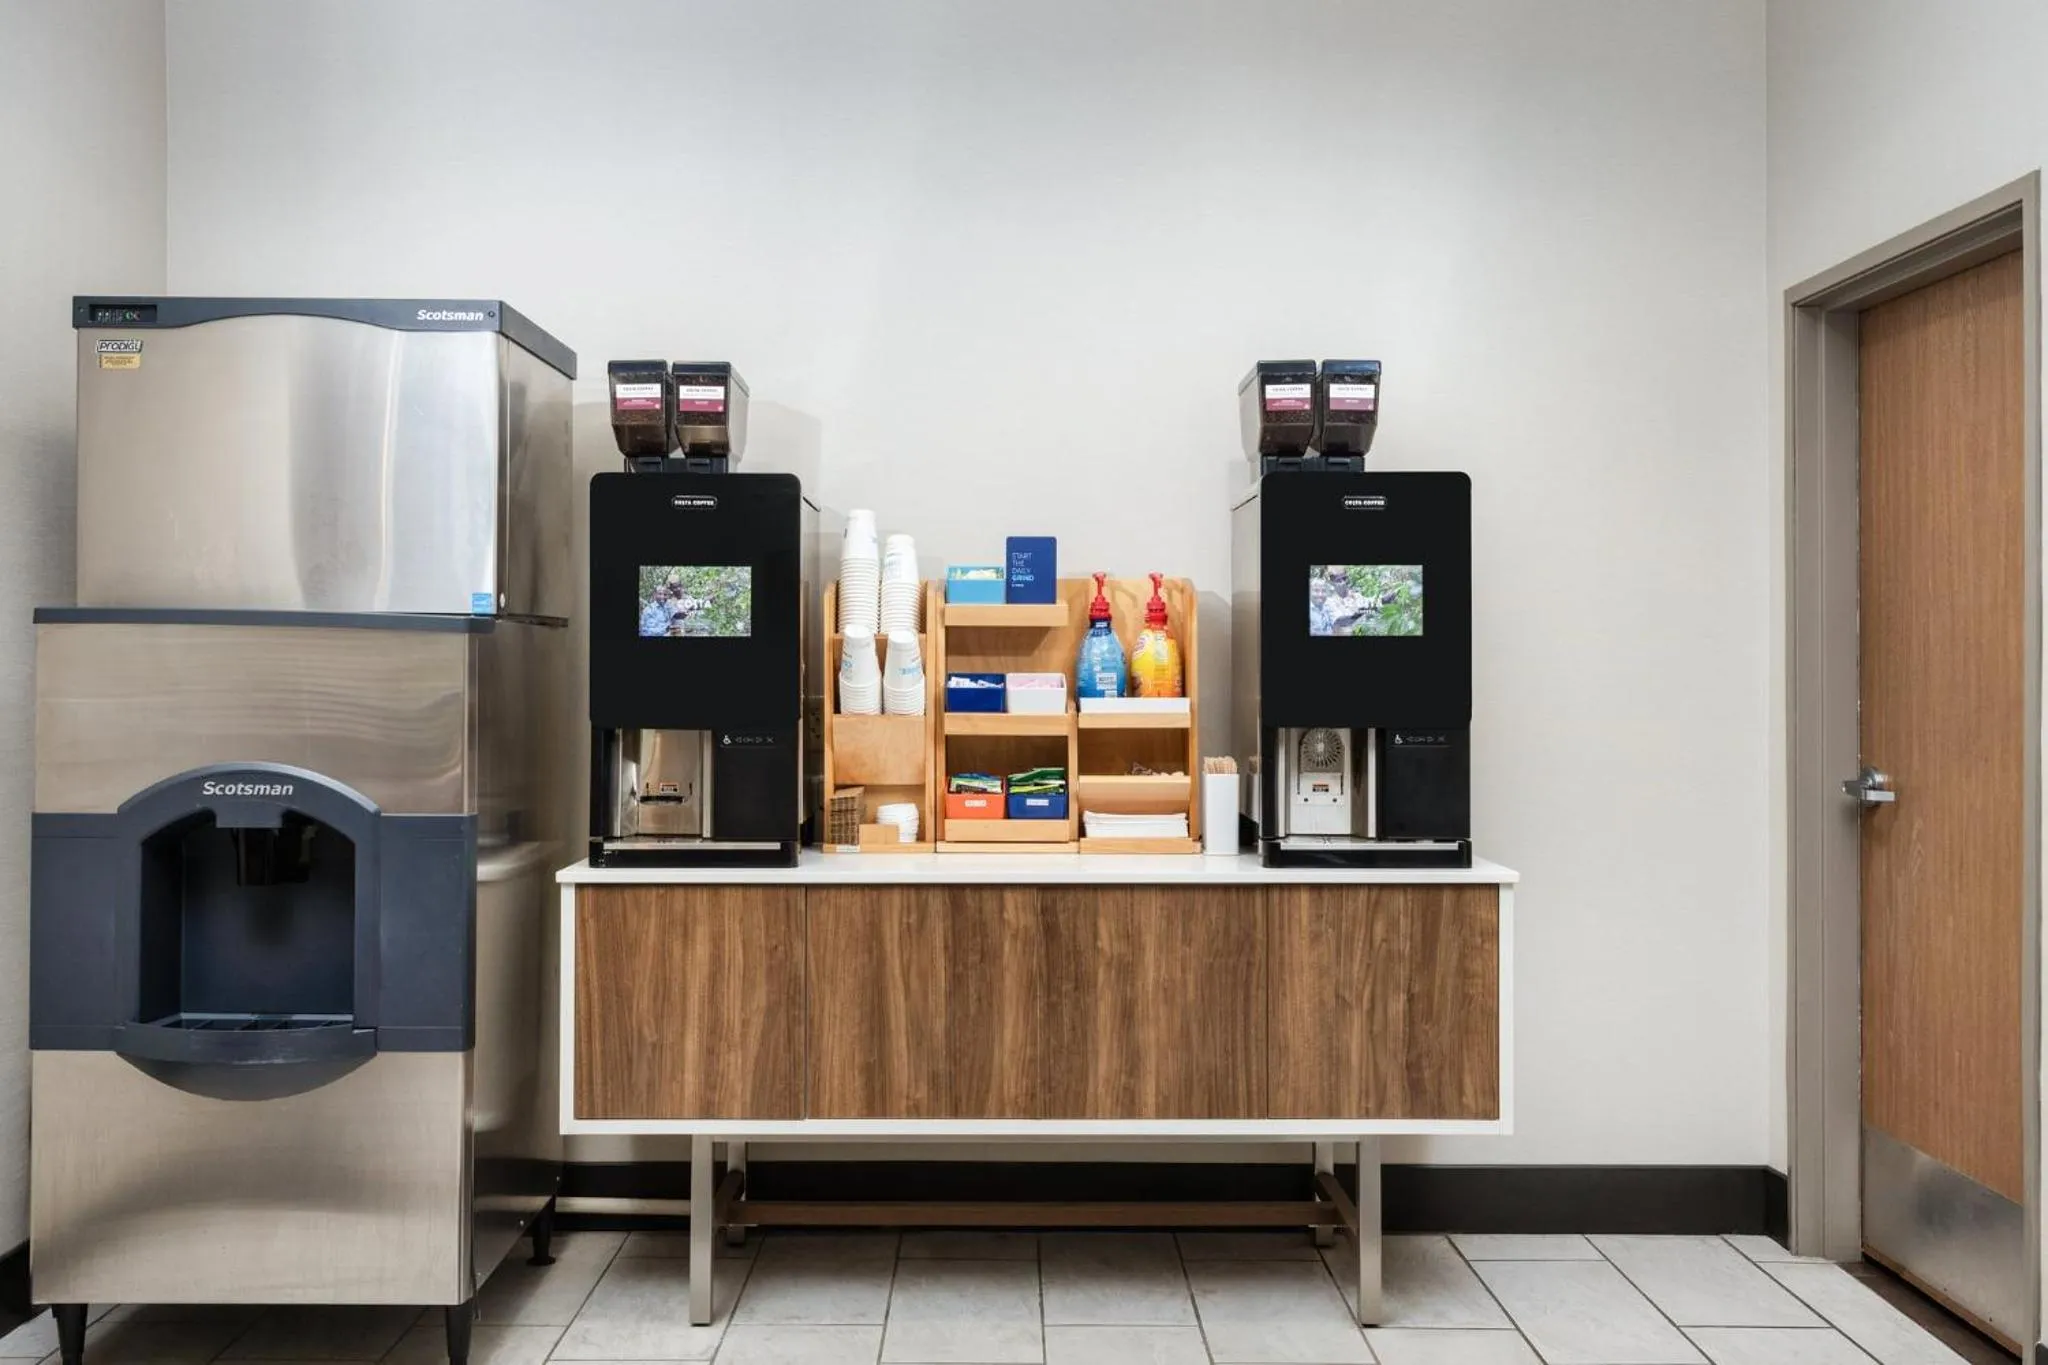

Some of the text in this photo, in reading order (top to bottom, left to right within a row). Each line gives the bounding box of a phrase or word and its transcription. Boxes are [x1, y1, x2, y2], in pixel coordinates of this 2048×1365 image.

[416, 309, 484, 321] Scotsman
[1012, 552, 1032, 560] START
[202, 781, 294, 795] Scotsman
